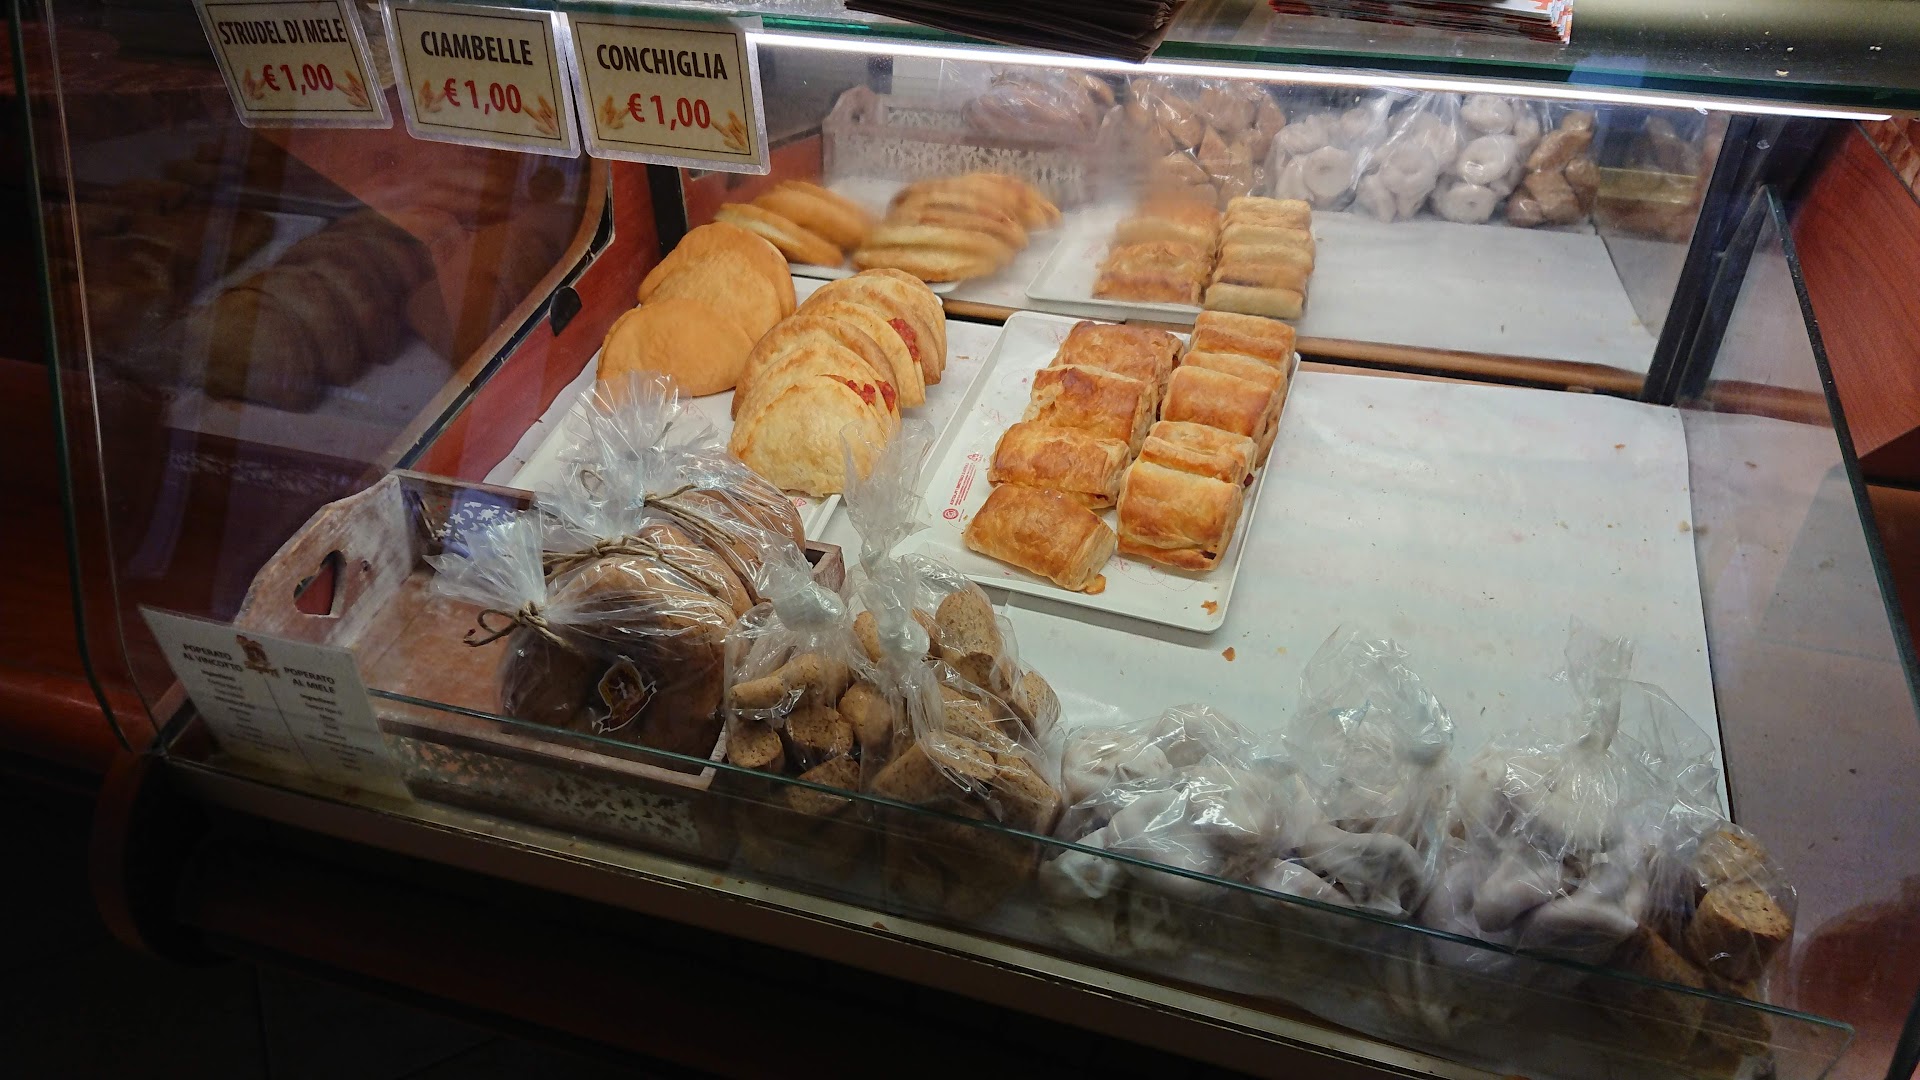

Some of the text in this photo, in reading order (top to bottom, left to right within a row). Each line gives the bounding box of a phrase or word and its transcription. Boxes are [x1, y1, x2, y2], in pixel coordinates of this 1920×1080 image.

[218, 18, 347, 45] STRUDEL DI MELE
[420, 30, 533, 66] CIAMBELLE
[596, 44, 728, 80] CONCHIGLIA
[279, 63, 334, 96] 1,00
[443, 78, 522, 115] € 1,00
[627, 93, 711, 131] € 1,00
[183, 643, 232, 661] POPERATO
[183, 652, 194, 662] AL
[196, 656, 244, 672] VINCOTTO
[283, 666, 335, 685] POPERATO
[292, 678, 335, 694] AL MIELE
